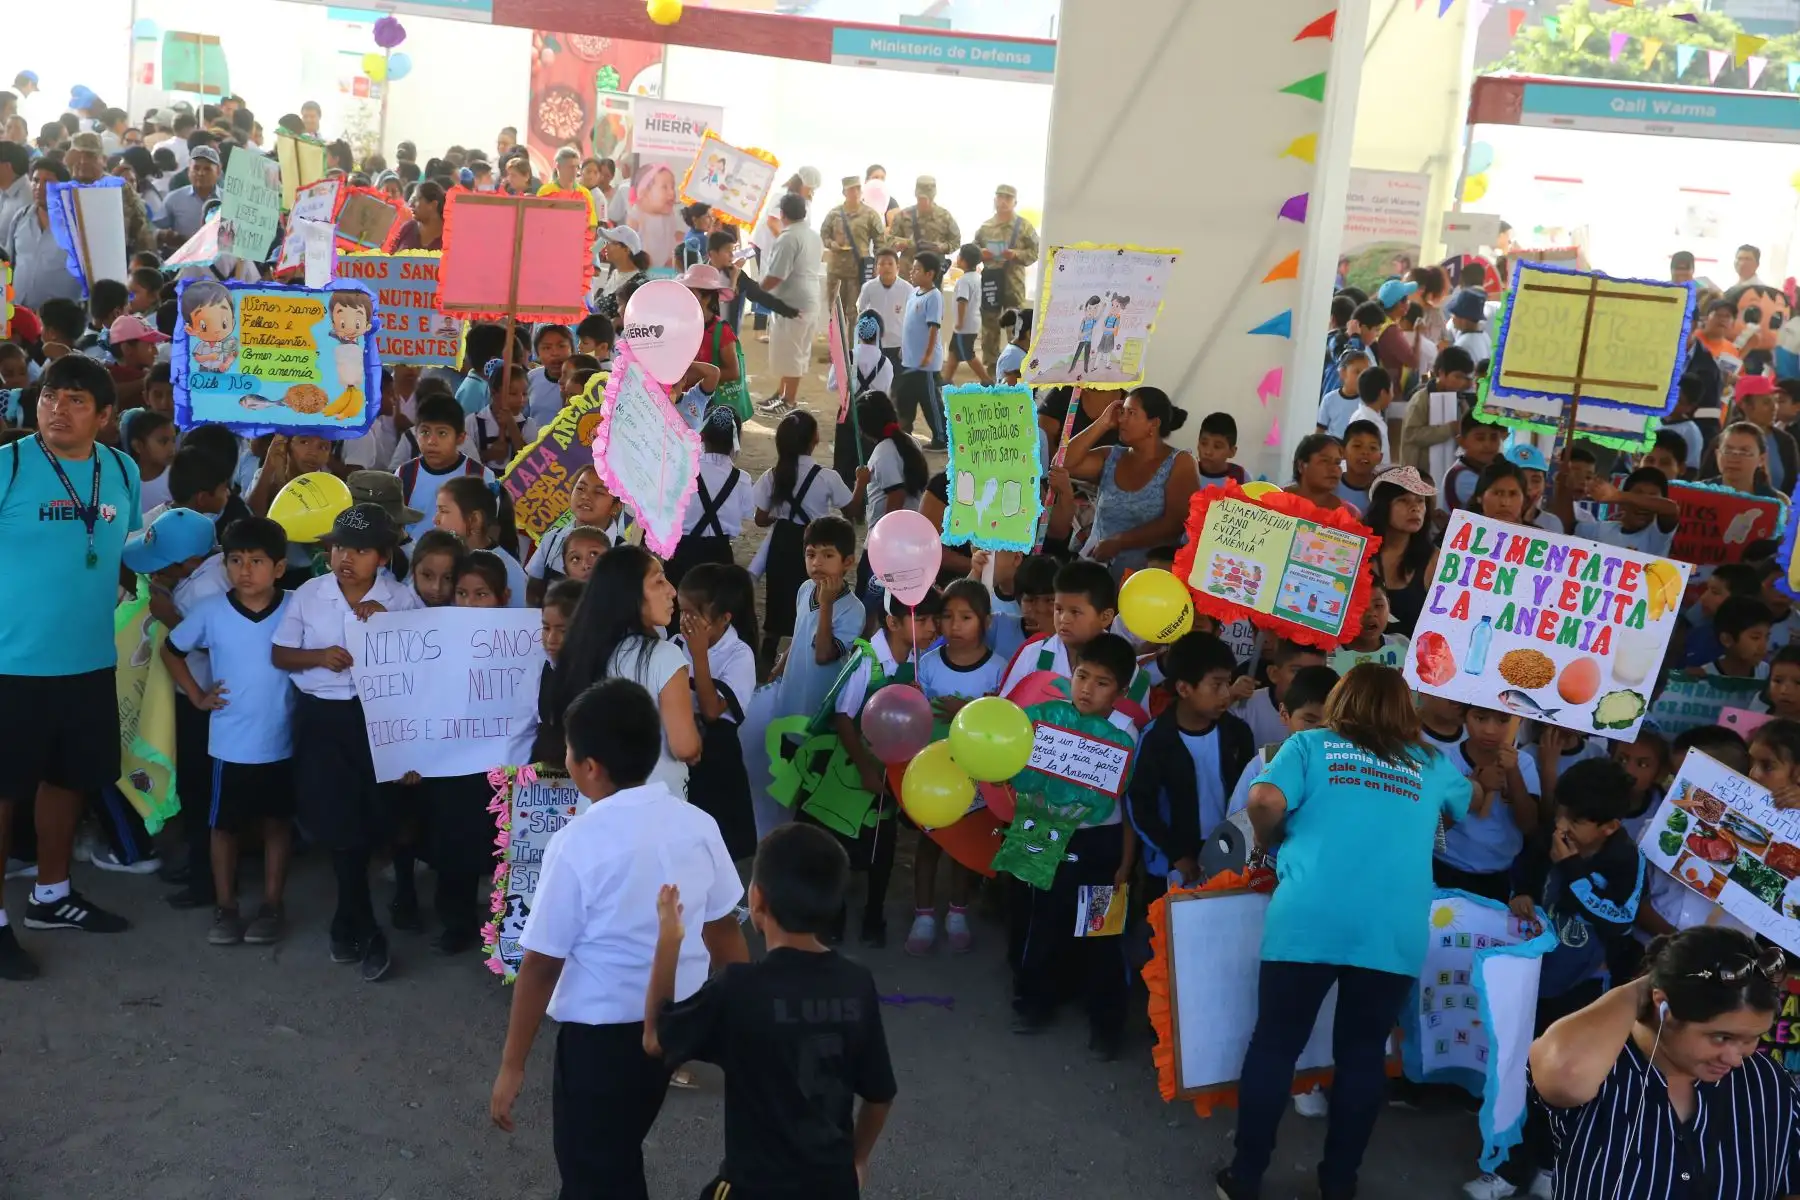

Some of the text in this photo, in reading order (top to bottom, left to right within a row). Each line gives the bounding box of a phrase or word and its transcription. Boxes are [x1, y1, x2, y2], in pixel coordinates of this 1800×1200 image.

[870, 38, 1032, 65] Ministerio de Defensa
[1610, 97, 1717, 118] Qali Warma
[241, 296, 281, 314] Niños
[228, 376, 253, 390] No
[994, 402, 1010, 421] bien
[1214, 535, 1256, 554] ANEMIA
[1250, 534, 1265, 546] LA
[1450, 522, 1642, 592] ALIMENTATE
[1438, 552, 1648, 630] BIEN Y EVITA
[1429, 584, 1613, 656] LA ANEMIA
[359, 671, 414, 703] BIEN
[425, 719, 435, 740] E
[1034, 726, 1055, 744] Soy
[1058, 737, 1074, 748] un
[1323, 741, 1354, 749] Para
[1033, 744, 1057, 757] verde
[1060, 752, 1068, 762] y
[1094, 762, 1119, 775] para
[1044, 760, 1057, 772] la
[1325, 752, 1374, 764] anemia
[1328, 762, 1422, 790] dale alimentos
[1725, 774, 1755, 797] SIN
[1328, 775, 1420, 802] ricos en hierro
[1710, 782, 1754, 816] MEJOR
[774, 998, 861, 1023] LUIS
